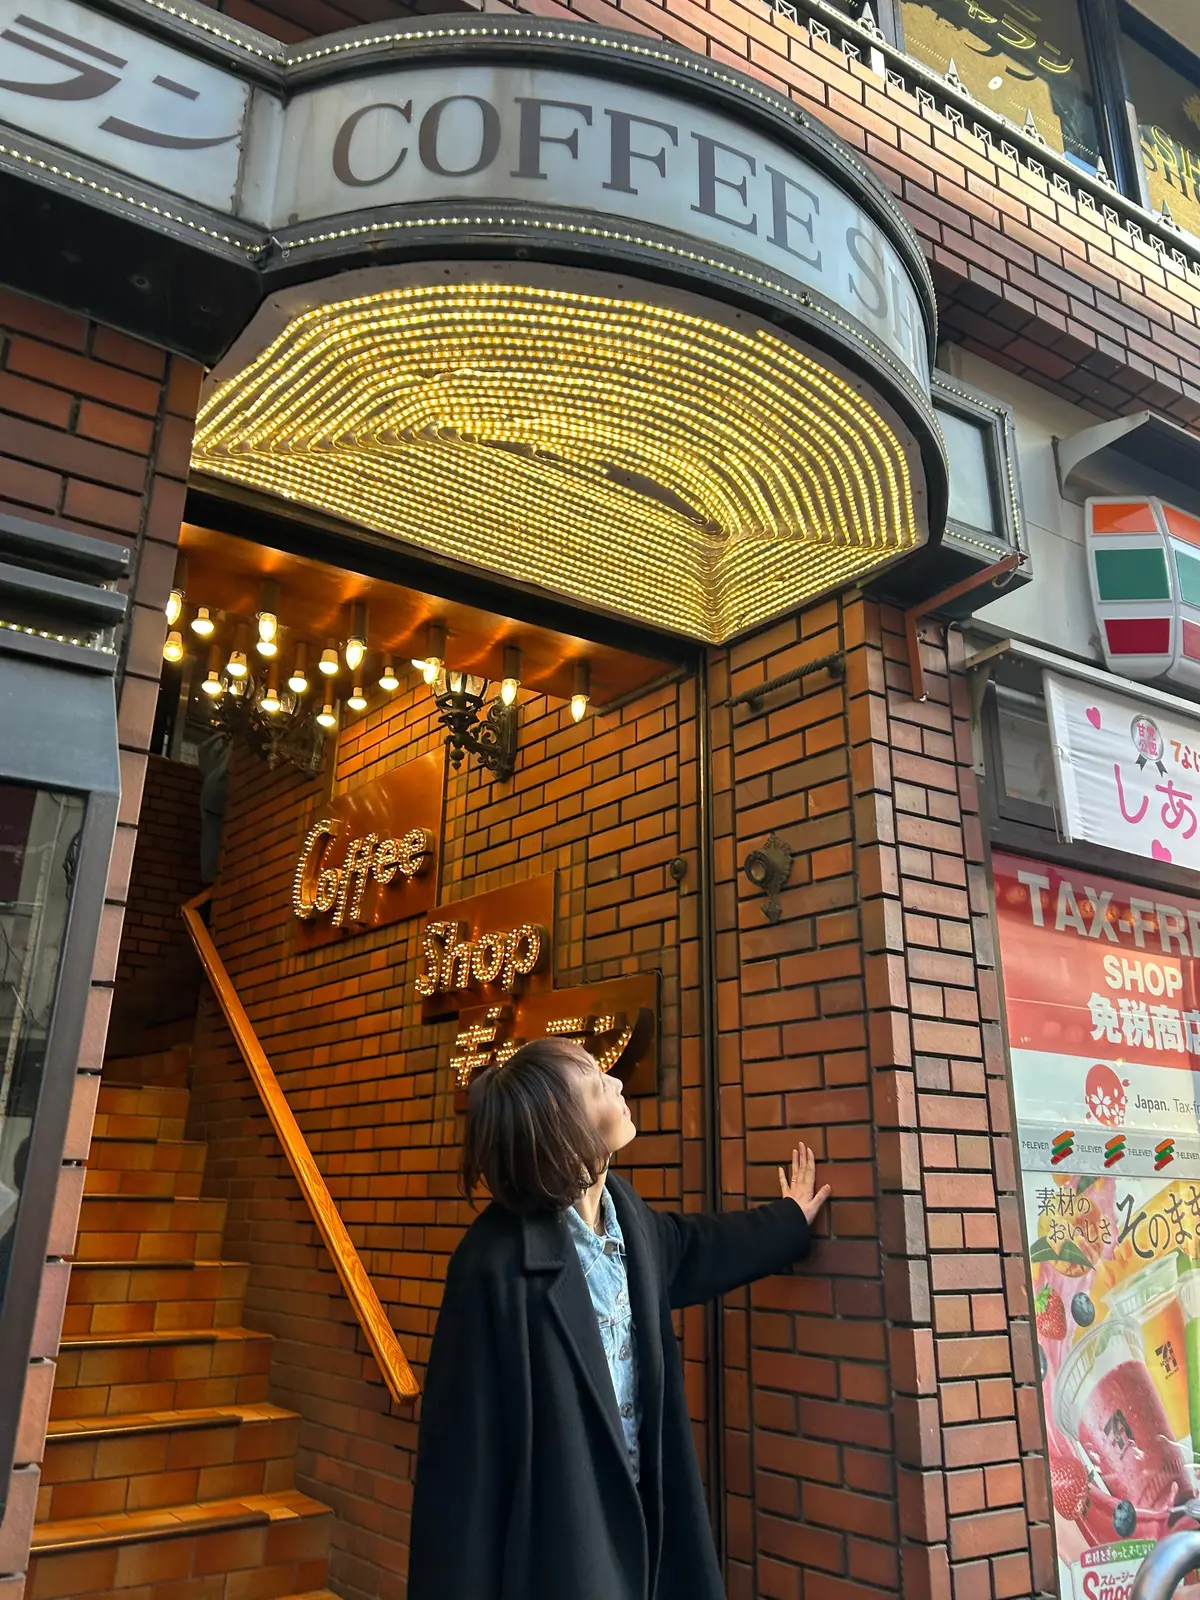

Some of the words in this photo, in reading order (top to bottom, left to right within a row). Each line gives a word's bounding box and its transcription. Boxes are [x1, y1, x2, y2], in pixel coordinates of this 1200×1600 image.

[332, 95, 823, 271] COFFEE
[293, 818, 433, 927] Coffee
[414, 920, 545, 996] Shop
[1103, 954, 1183, 998] SHOP
[1135, 1094, 1170, 1113] Japan.
[1035, 1186, 1091, 1217] 素材の
[1049, 1218, 1112, 1245] おいしさ
